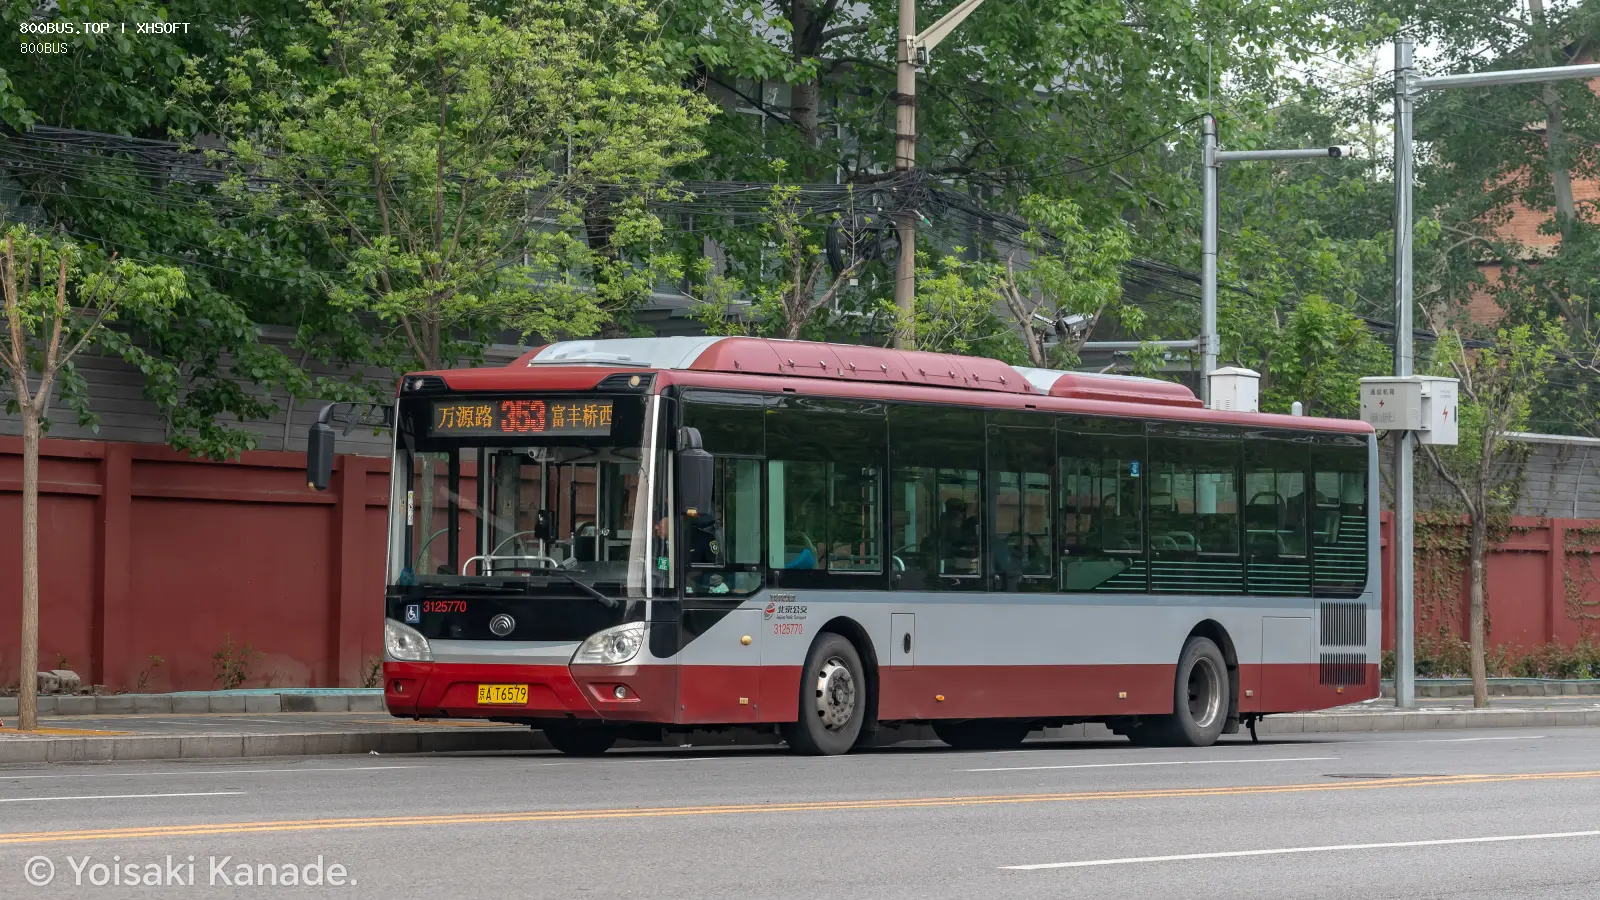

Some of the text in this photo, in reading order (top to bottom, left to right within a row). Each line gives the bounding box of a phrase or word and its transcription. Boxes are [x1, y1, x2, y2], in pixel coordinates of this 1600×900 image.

[437, 400, 613, 432] 万源路 353 富丰桥西
[423, 600, 467, 613] 3125770
[777, 605, 808, 614] 北京公交
[773, 623, 803, 635] 3125770
